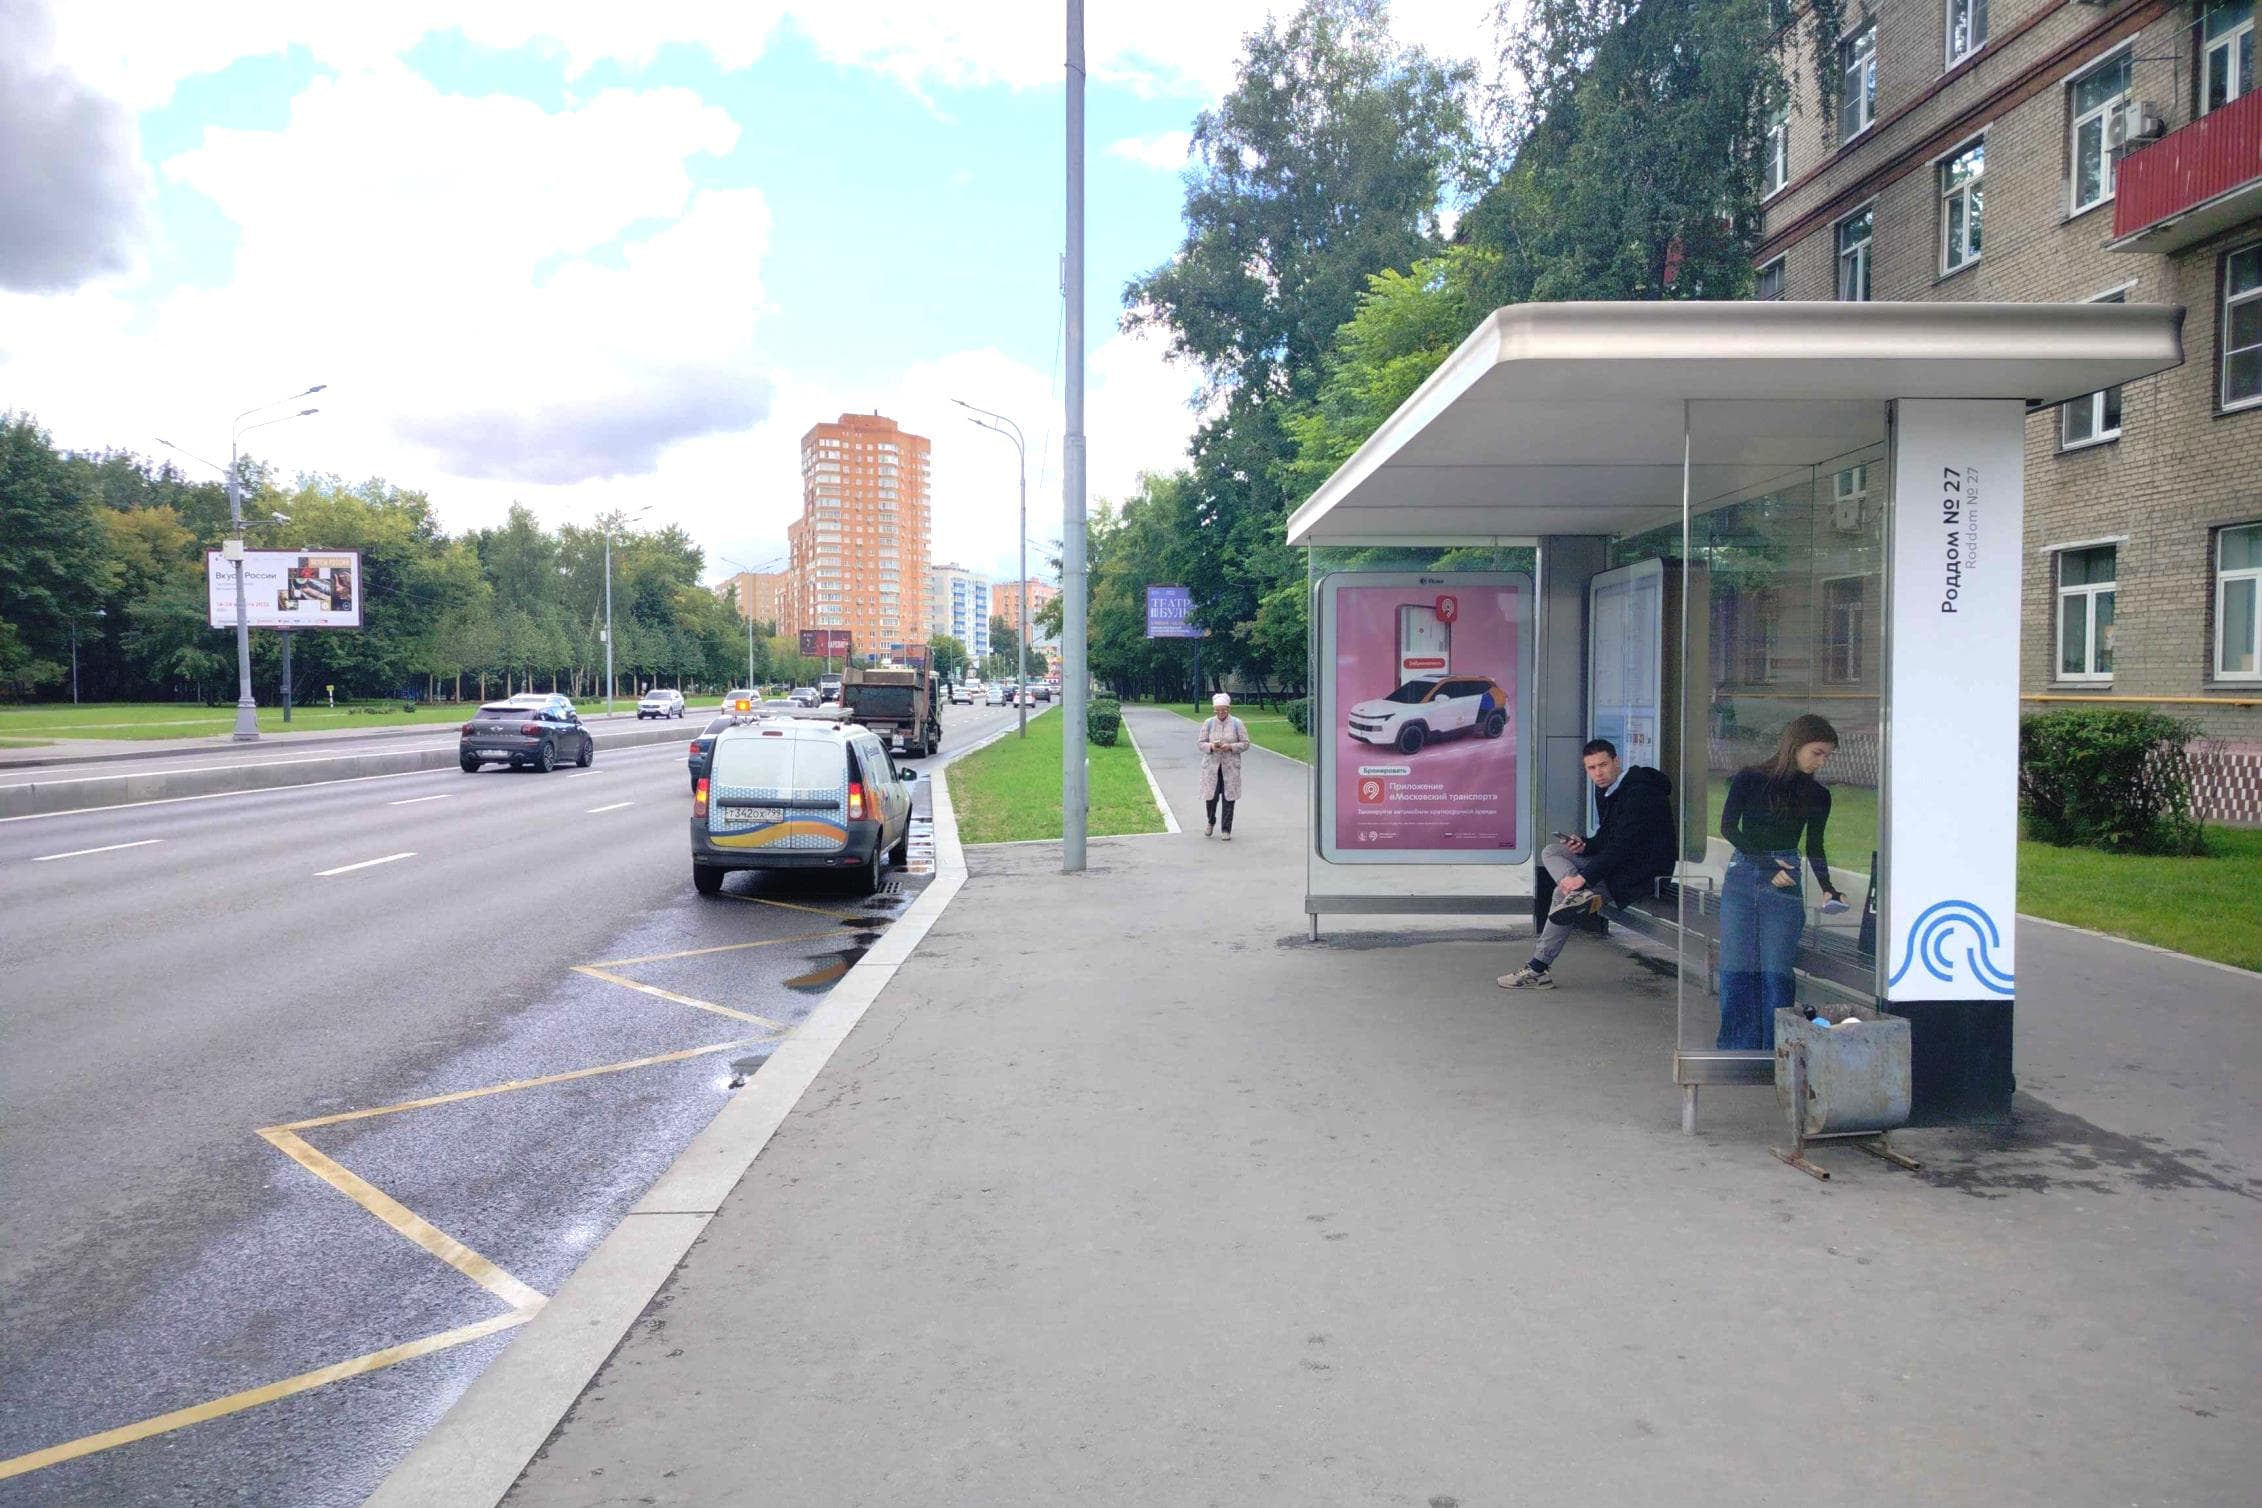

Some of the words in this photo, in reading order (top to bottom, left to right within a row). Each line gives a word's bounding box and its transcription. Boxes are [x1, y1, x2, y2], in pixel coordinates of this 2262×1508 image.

[1943, 467, 1961, 493] 27
[1967, 467, 1979, 484] 27
[1967, 488, 1978, 505] №
[1943, 499, 1960, 524] №
[1965, 510, 1977, 569] Roddom
[244, 571, 277, 580] России
[1941, 531, 1961, 613] Роддом
[1363, 766, 1407, 775] Бронировать
[1389, 782, 1443, 791] Приложение
[1389, 792, 1447, 801] «Московский
[1449, 793, 1498, 802] транспорт»
